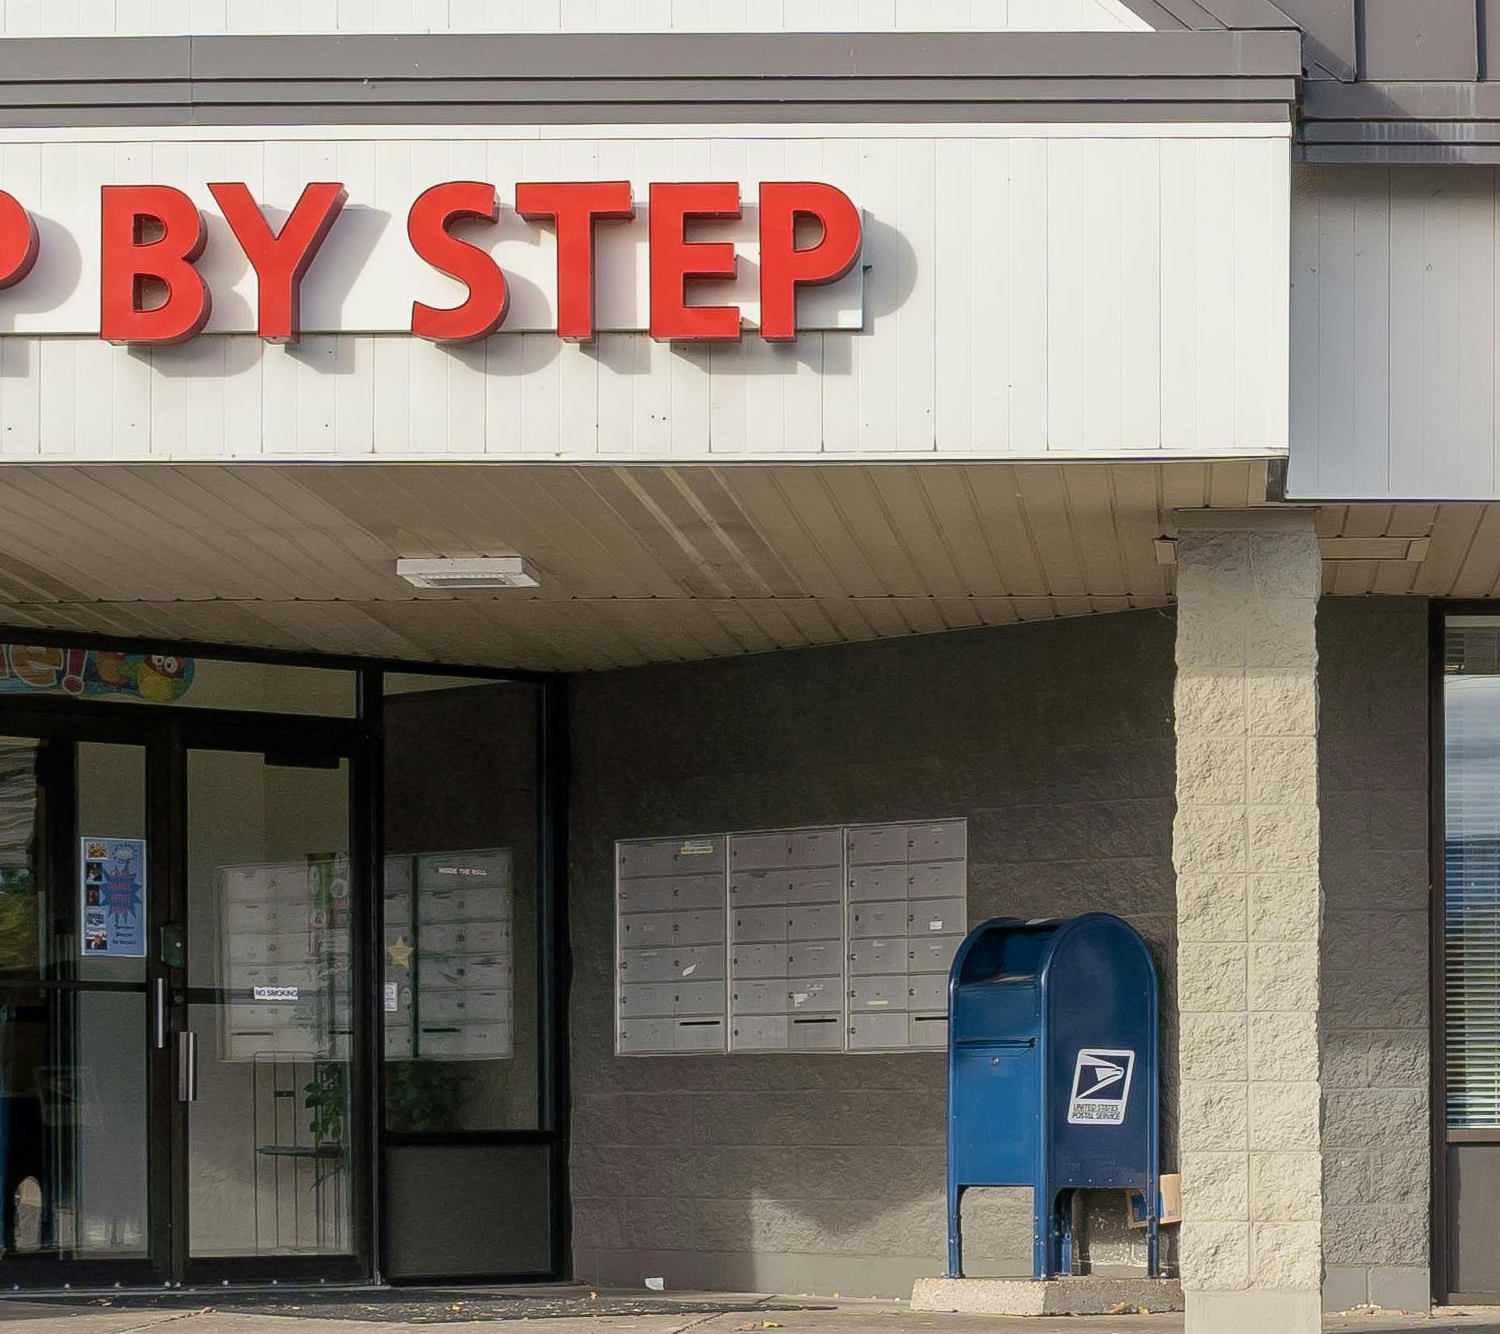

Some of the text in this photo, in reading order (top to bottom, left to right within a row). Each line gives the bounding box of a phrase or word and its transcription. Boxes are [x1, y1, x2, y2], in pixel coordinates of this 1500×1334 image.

[99, 182, 345, 343] BY
[408, 181, 862, 341] STEP
[1073, 1103, 1119, 1111] UNITED STATES
[1072, 1111, 1120, 1120] POSTAL SERVICE
